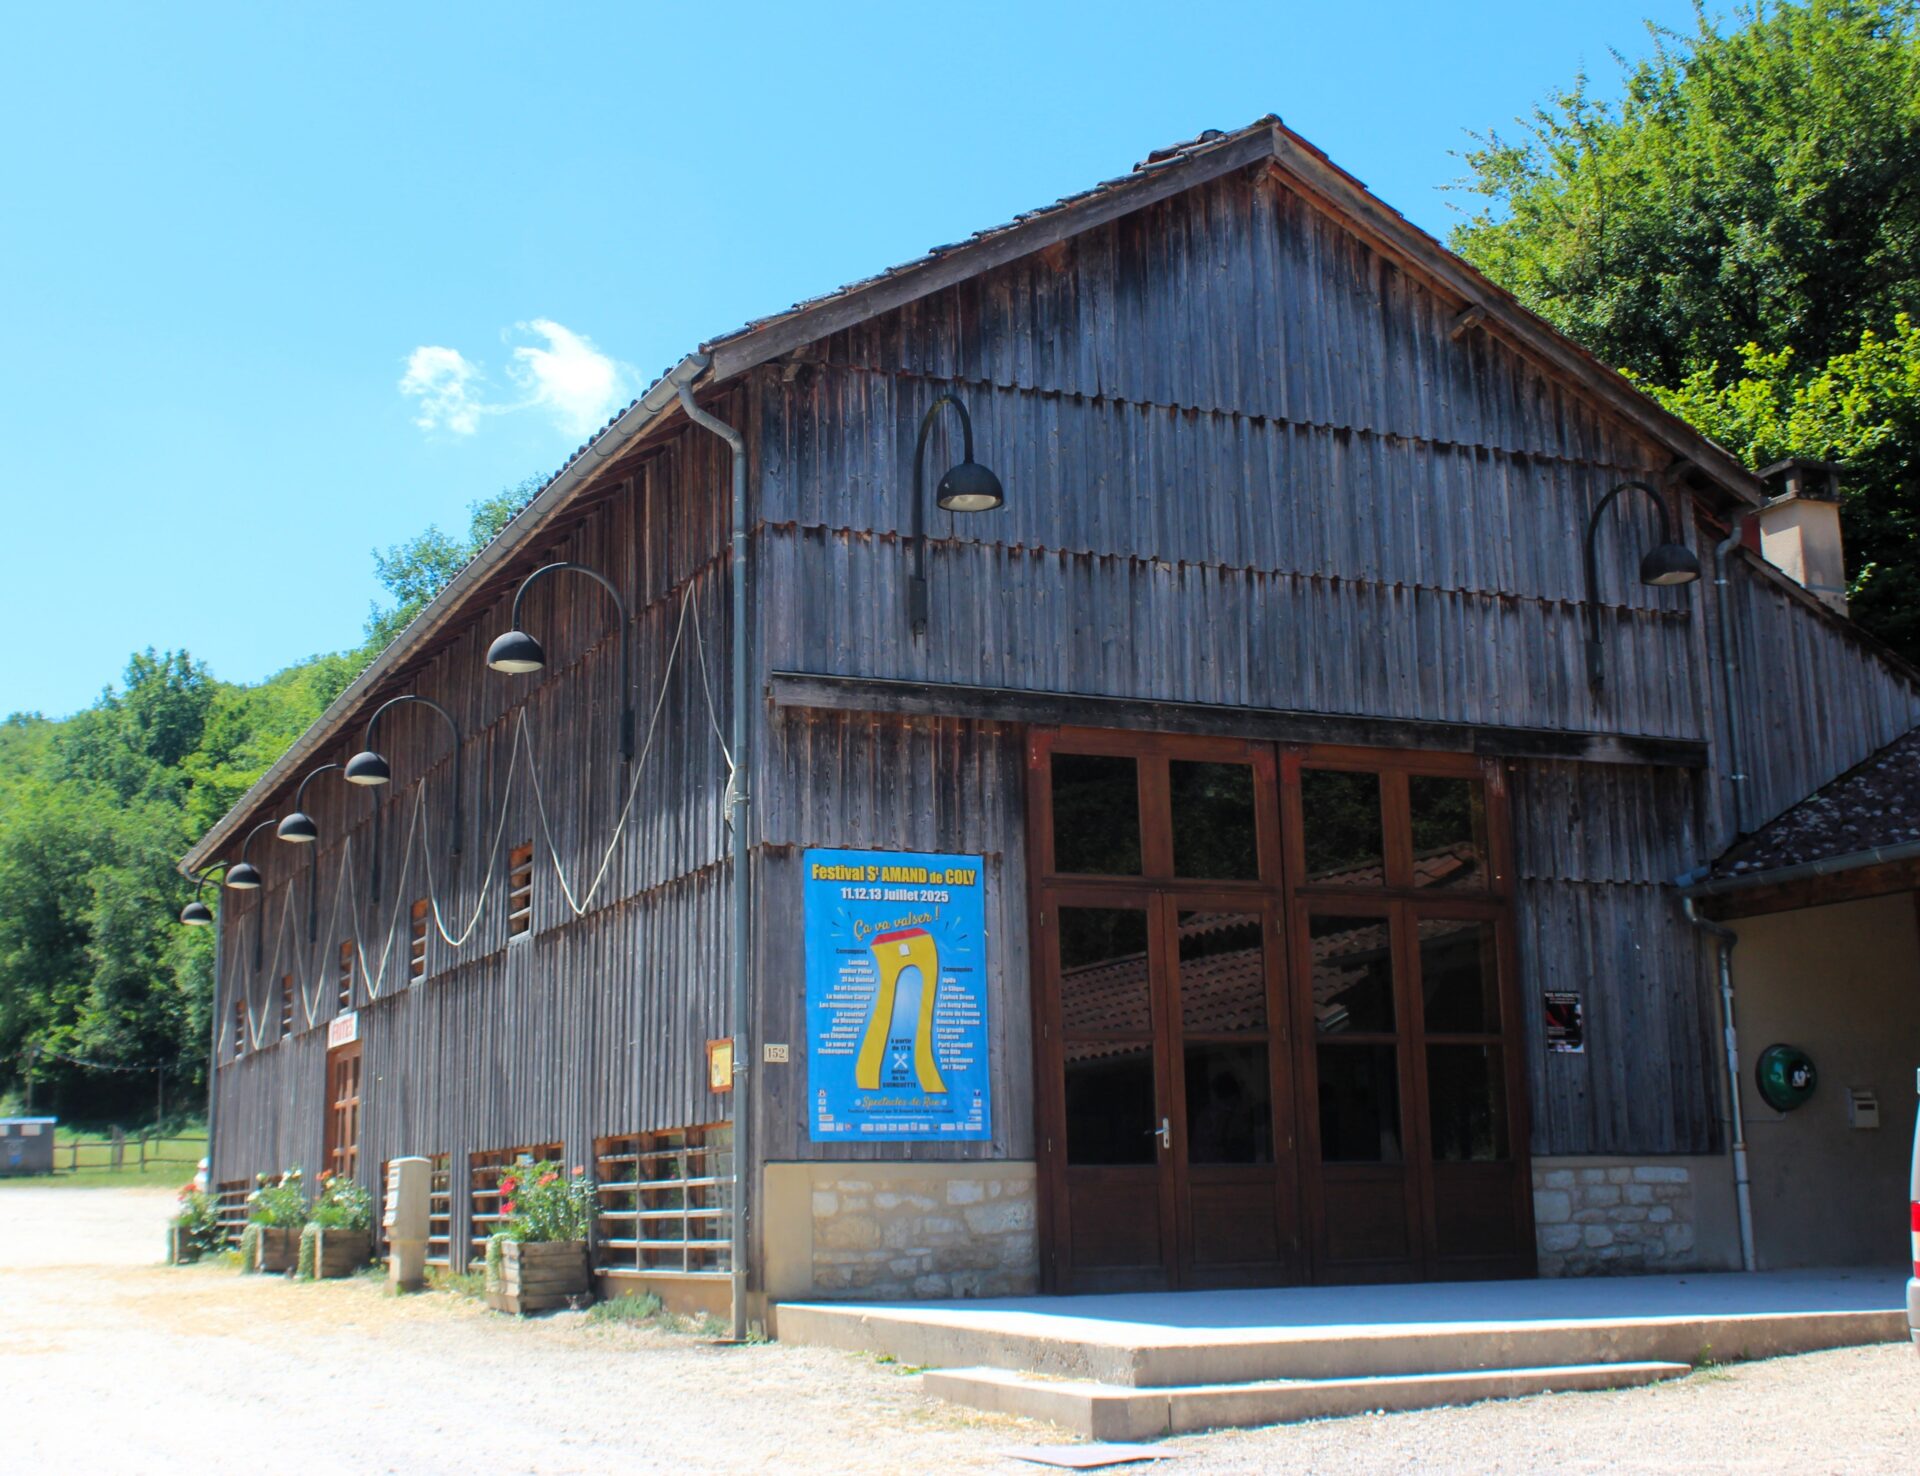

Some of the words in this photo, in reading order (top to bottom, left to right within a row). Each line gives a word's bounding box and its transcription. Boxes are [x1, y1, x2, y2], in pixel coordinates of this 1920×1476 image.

[811, 863, 865, 881] Festival
[881, 866, 927, 884] AMAND
[929, 871, 943, 884] de
[945, 869, 976, 885] COLY
[840, 887, 882, 900] 11.12.13
[883, 888, 919, 901] Juillet
[920, 889, 949, 902] 2025
[853, 919, 871, 942] Ça
[875, 921, 891, 931] va
[893, 911, 933, 927] valser
[768, 1047, 785, 1059] 152
